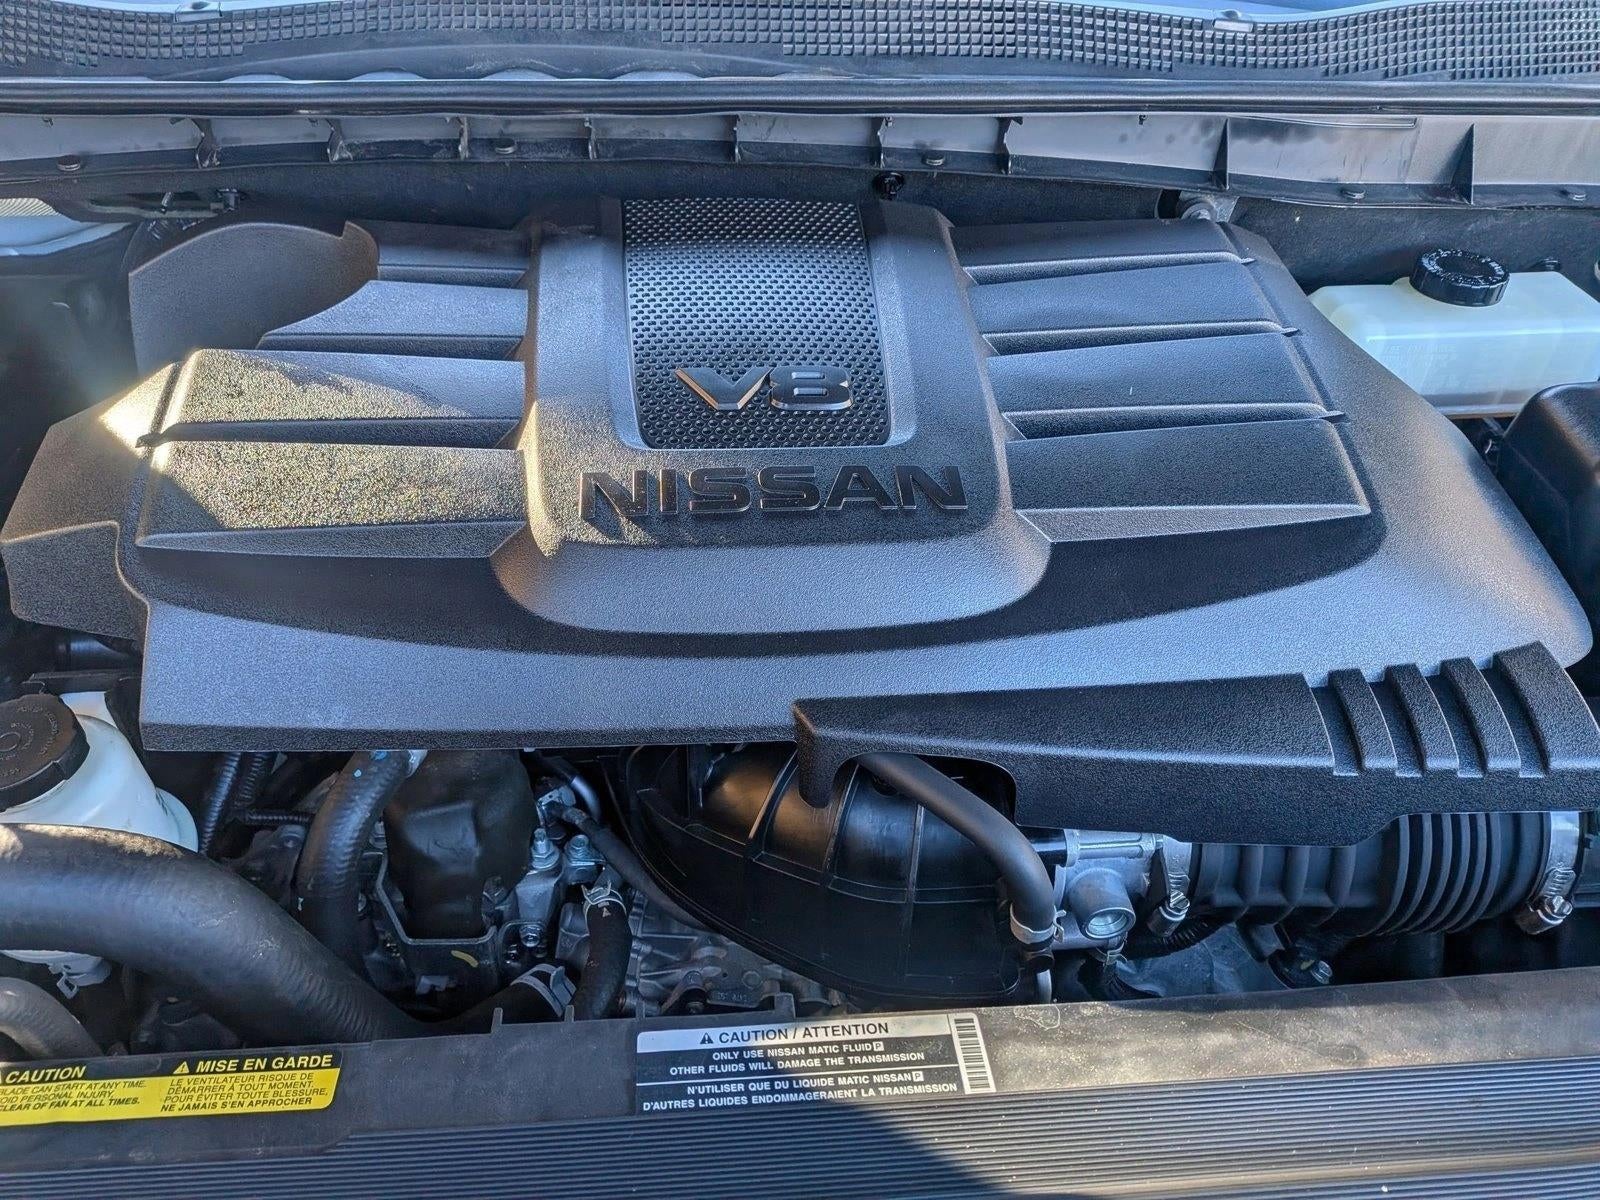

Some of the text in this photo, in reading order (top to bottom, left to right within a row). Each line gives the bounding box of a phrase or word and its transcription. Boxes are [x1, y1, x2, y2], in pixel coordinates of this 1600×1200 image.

[675, 366, 853, 411] V8
[579, 465, 969, 518] NISSAN
[719, 1028, 788, 1044] CAUTION
[802, 1022, 889, 1039] ATTENTION
[712, 1050, 740, 1061] ONLY
[743, 1049, 764, 1059] USE
[767, 1048, 806, 1058] NISSAN
[808, 1044, 840, 1054] MATIC
[195, 1054, 333, 1074] MISE EN GARDE
[670, 1052, 925, 1076] OTHER FLUIDS WILL DAMAGE THE TRANSMISSION
[5, 1066, 87, 1084] CAUTION
[170, 1072, 314, 1087] LE VENTILATEUR RISQUE DE
[31, 1084, 52, 1094] CAN
[54, 1082, 84, 1092] START
[84, 1081, 98, 1091] AT
[100, 1081, 120, 1090] ANY
[167, 1085, 225, 1095] DÉMARRER
[239, 1083, 266, 1092] TOUT
[687, 1083, 745, 1095] N'UTILISER
[748, 1082, 771, 1092] QUE
[774, 1081, 789, 1090] DU
[792, 1077, 835, 1089] LIQUIDE
[838, 1075, 869, 1086] MATIC
[873, 1073, 912, 1083] NISSAN
[20, 1093, 73, 1104] PERSONAL
[32, 1102, 48, 1111] OF
[49, 1101, 69, 1110] FAN
[71, 1100, 84, 1108] AT
[85, 1099, 105, 1107] ALL
[108, 1097, 140, 1106] TIMES.
[160, 1097, 312, 1112] NE JAMAIS S'EN APPROCHER
[164, 1095, 194, 1104] POUR
[237, 1090, 270, 1100] TOUTE
[273, 1088, 328, 1098] BLESSURE,
[643, 1083, 958, 1112] D'AUTRES LIQUIDES ENDOMMAGERAIENT LA TRANSMISSION
